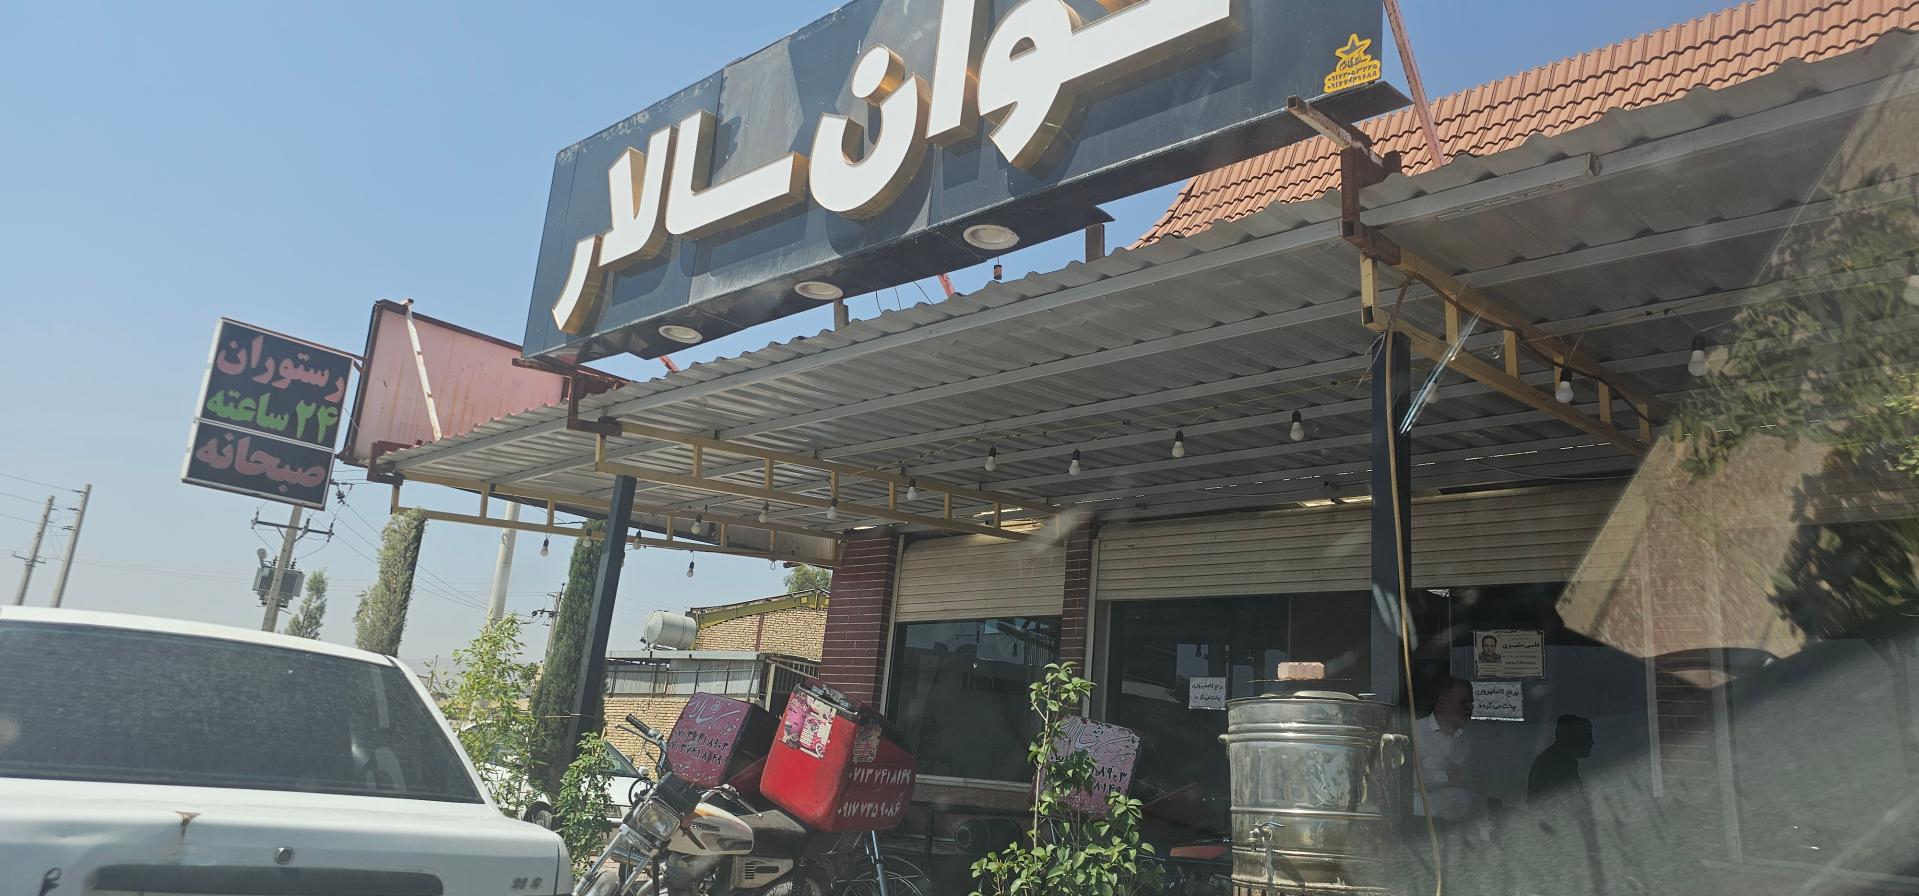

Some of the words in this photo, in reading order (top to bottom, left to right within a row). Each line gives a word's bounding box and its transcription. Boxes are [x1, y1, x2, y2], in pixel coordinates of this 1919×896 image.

[552, 108, 806, 334] سالار
[216, 334, 346, 403] رستوران
[206, 390, 289, 431] ساعته
[296, 400, 338, 444] ۲۴
[196, 432, 326, 493] صبحانه
